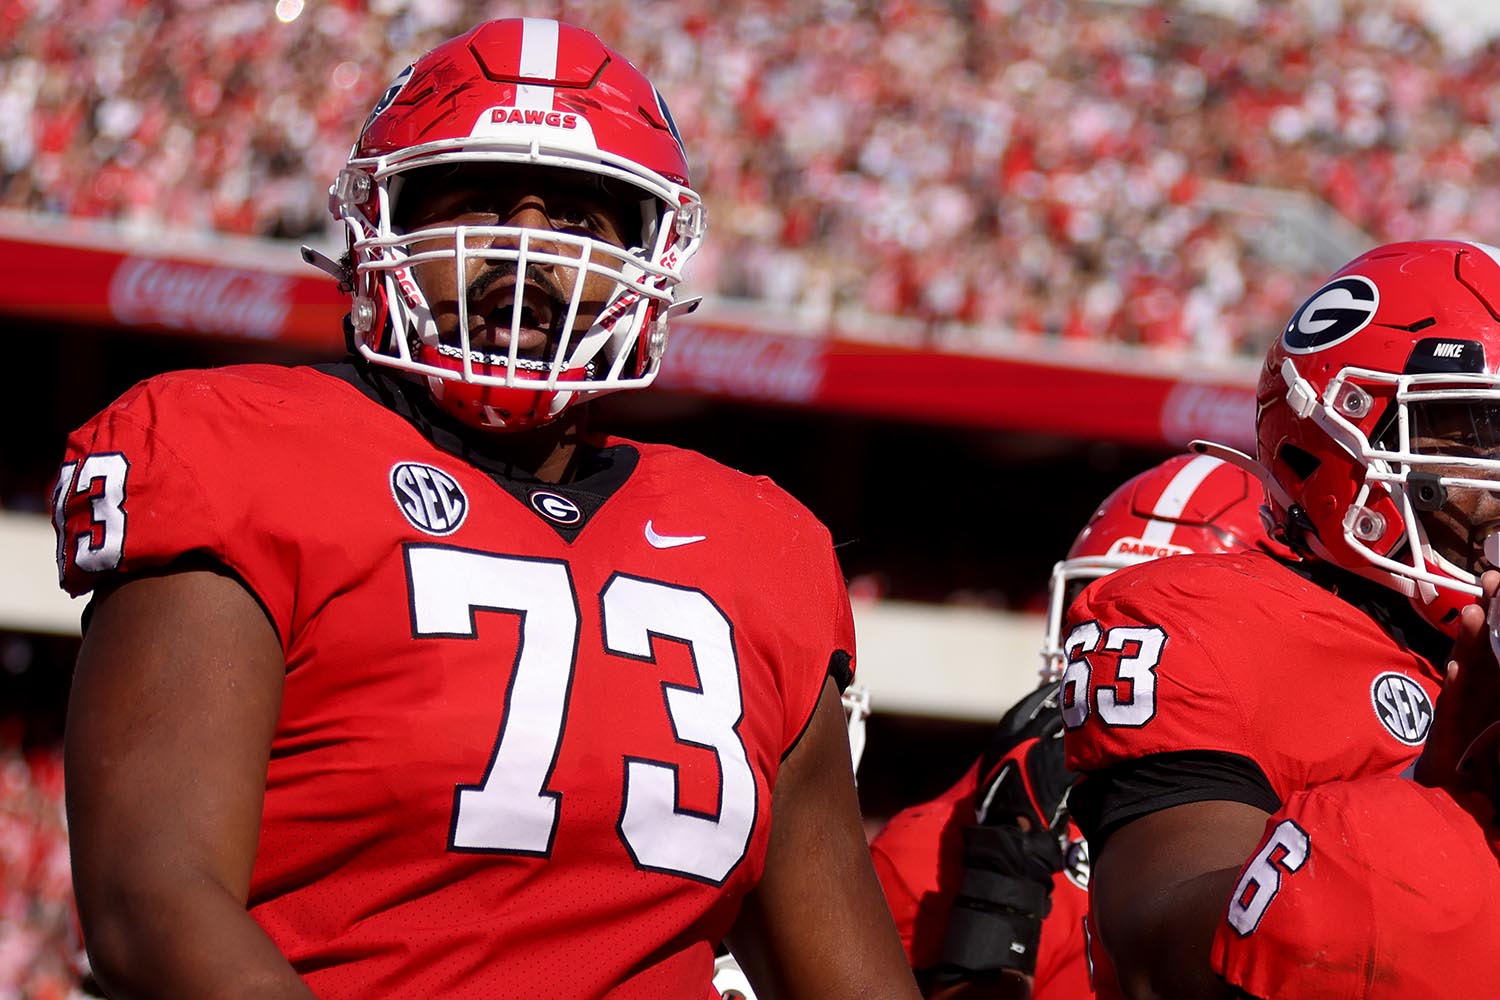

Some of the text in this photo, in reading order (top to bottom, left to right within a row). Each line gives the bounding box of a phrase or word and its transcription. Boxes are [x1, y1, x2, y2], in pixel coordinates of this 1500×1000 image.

[490, 108, 578, 130] DAWGS
[1432, 342, 1465, 359] NIKE
[394, 464, 466, 533] SEC
[1059, 619, 1169, 730] 63
[1375, 675, 1432, 743] SEC
[401, 541, 759, 888] 73
[1226, 818, 1312, 937] 6
